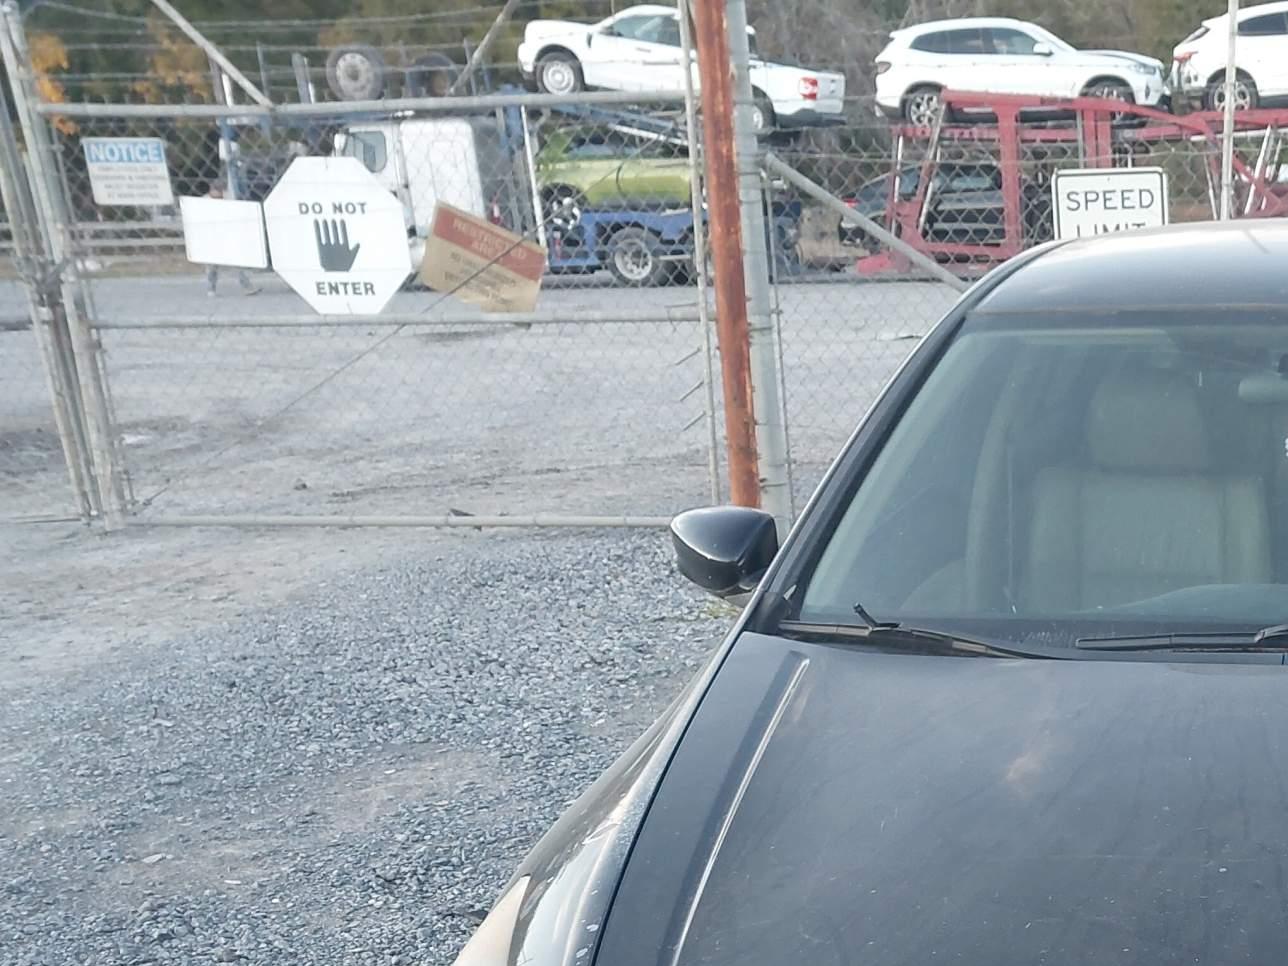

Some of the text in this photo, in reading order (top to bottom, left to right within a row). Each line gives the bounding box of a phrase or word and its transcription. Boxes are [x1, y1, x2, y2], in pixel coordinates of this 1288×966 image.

[89, 143, 161, 161] NOTICE
[1066, 188, 1154, 211] SPEED
[298, 202, 367, 215] DO NOT
[1076, 222, 1146, 238] LIM
[316, 281, 376, 296] ENTER
